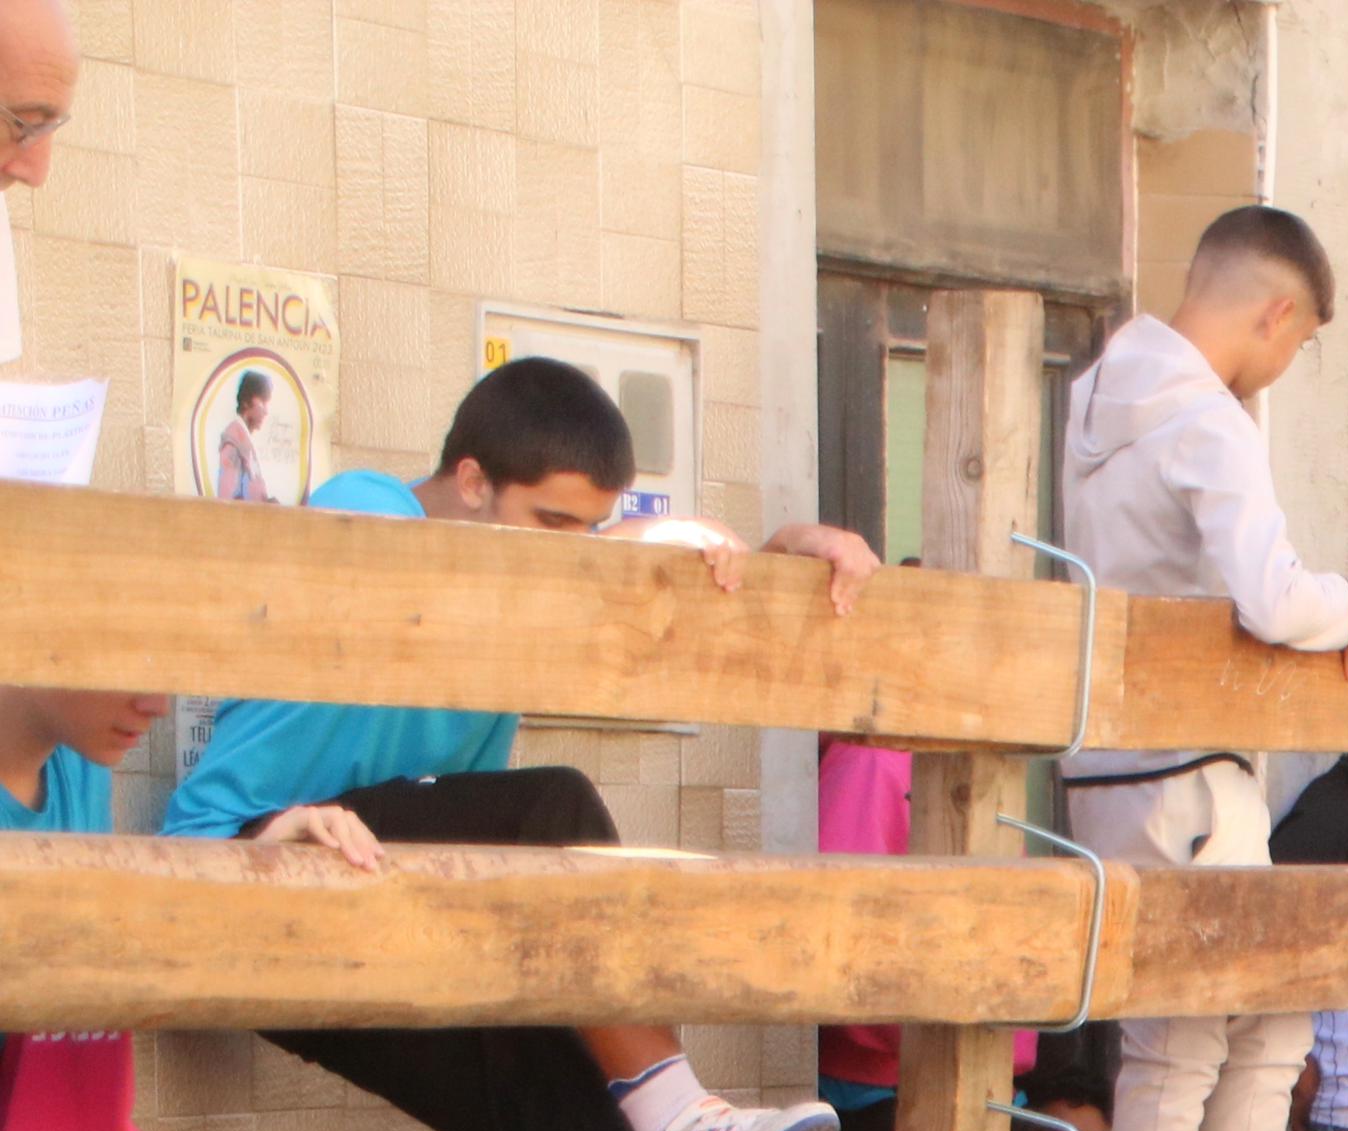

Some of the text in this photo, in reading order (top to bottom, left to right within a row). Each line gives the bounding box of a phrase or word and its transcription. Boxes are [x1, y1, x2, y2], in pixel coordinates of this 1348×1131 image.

[182, 279, 332, 340] PALENCIA
[182, 323, 207, 337] FERIA
[207, 326, 243, 342] TAURINA
[244, 332, 256, 343] DE
[257, 333, 275, 346] SAN
[485, 341, 508, 364] 01
[623, 493, 638, 512] B2
